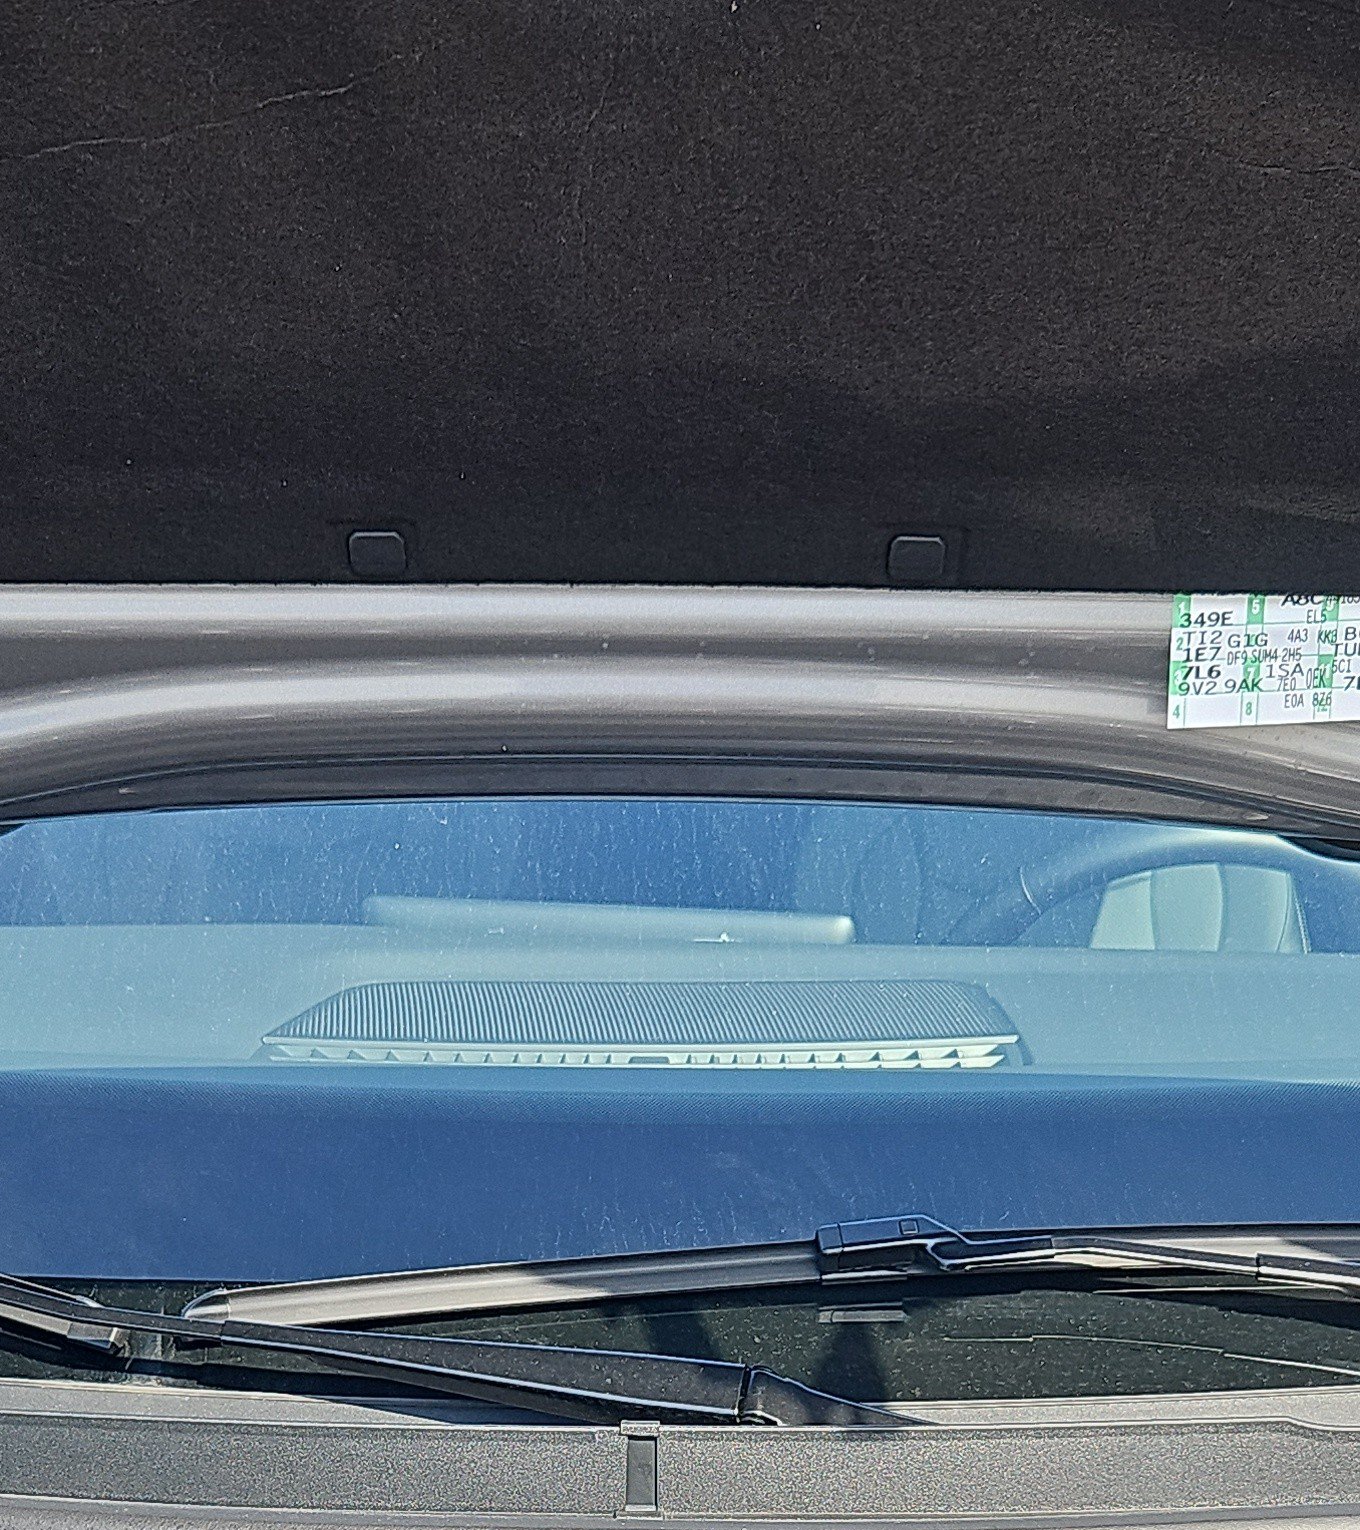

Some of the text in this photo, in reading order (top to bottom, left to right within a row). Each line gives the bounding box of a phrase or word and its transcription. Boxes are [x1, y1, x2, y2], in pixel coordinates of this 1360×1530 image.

[1180, 610, 1233, 628] 349E
[1306, 608, 1327, 624] EL5
[1287, 628, 1308, 642] 4A3
[1181, 646, 1222, 663] 1E7
[1180, 664, 1222, 680] 7L6
[1265, 662, 1304, 678] 1SA
[1245, 701, 1253, 716] 8
